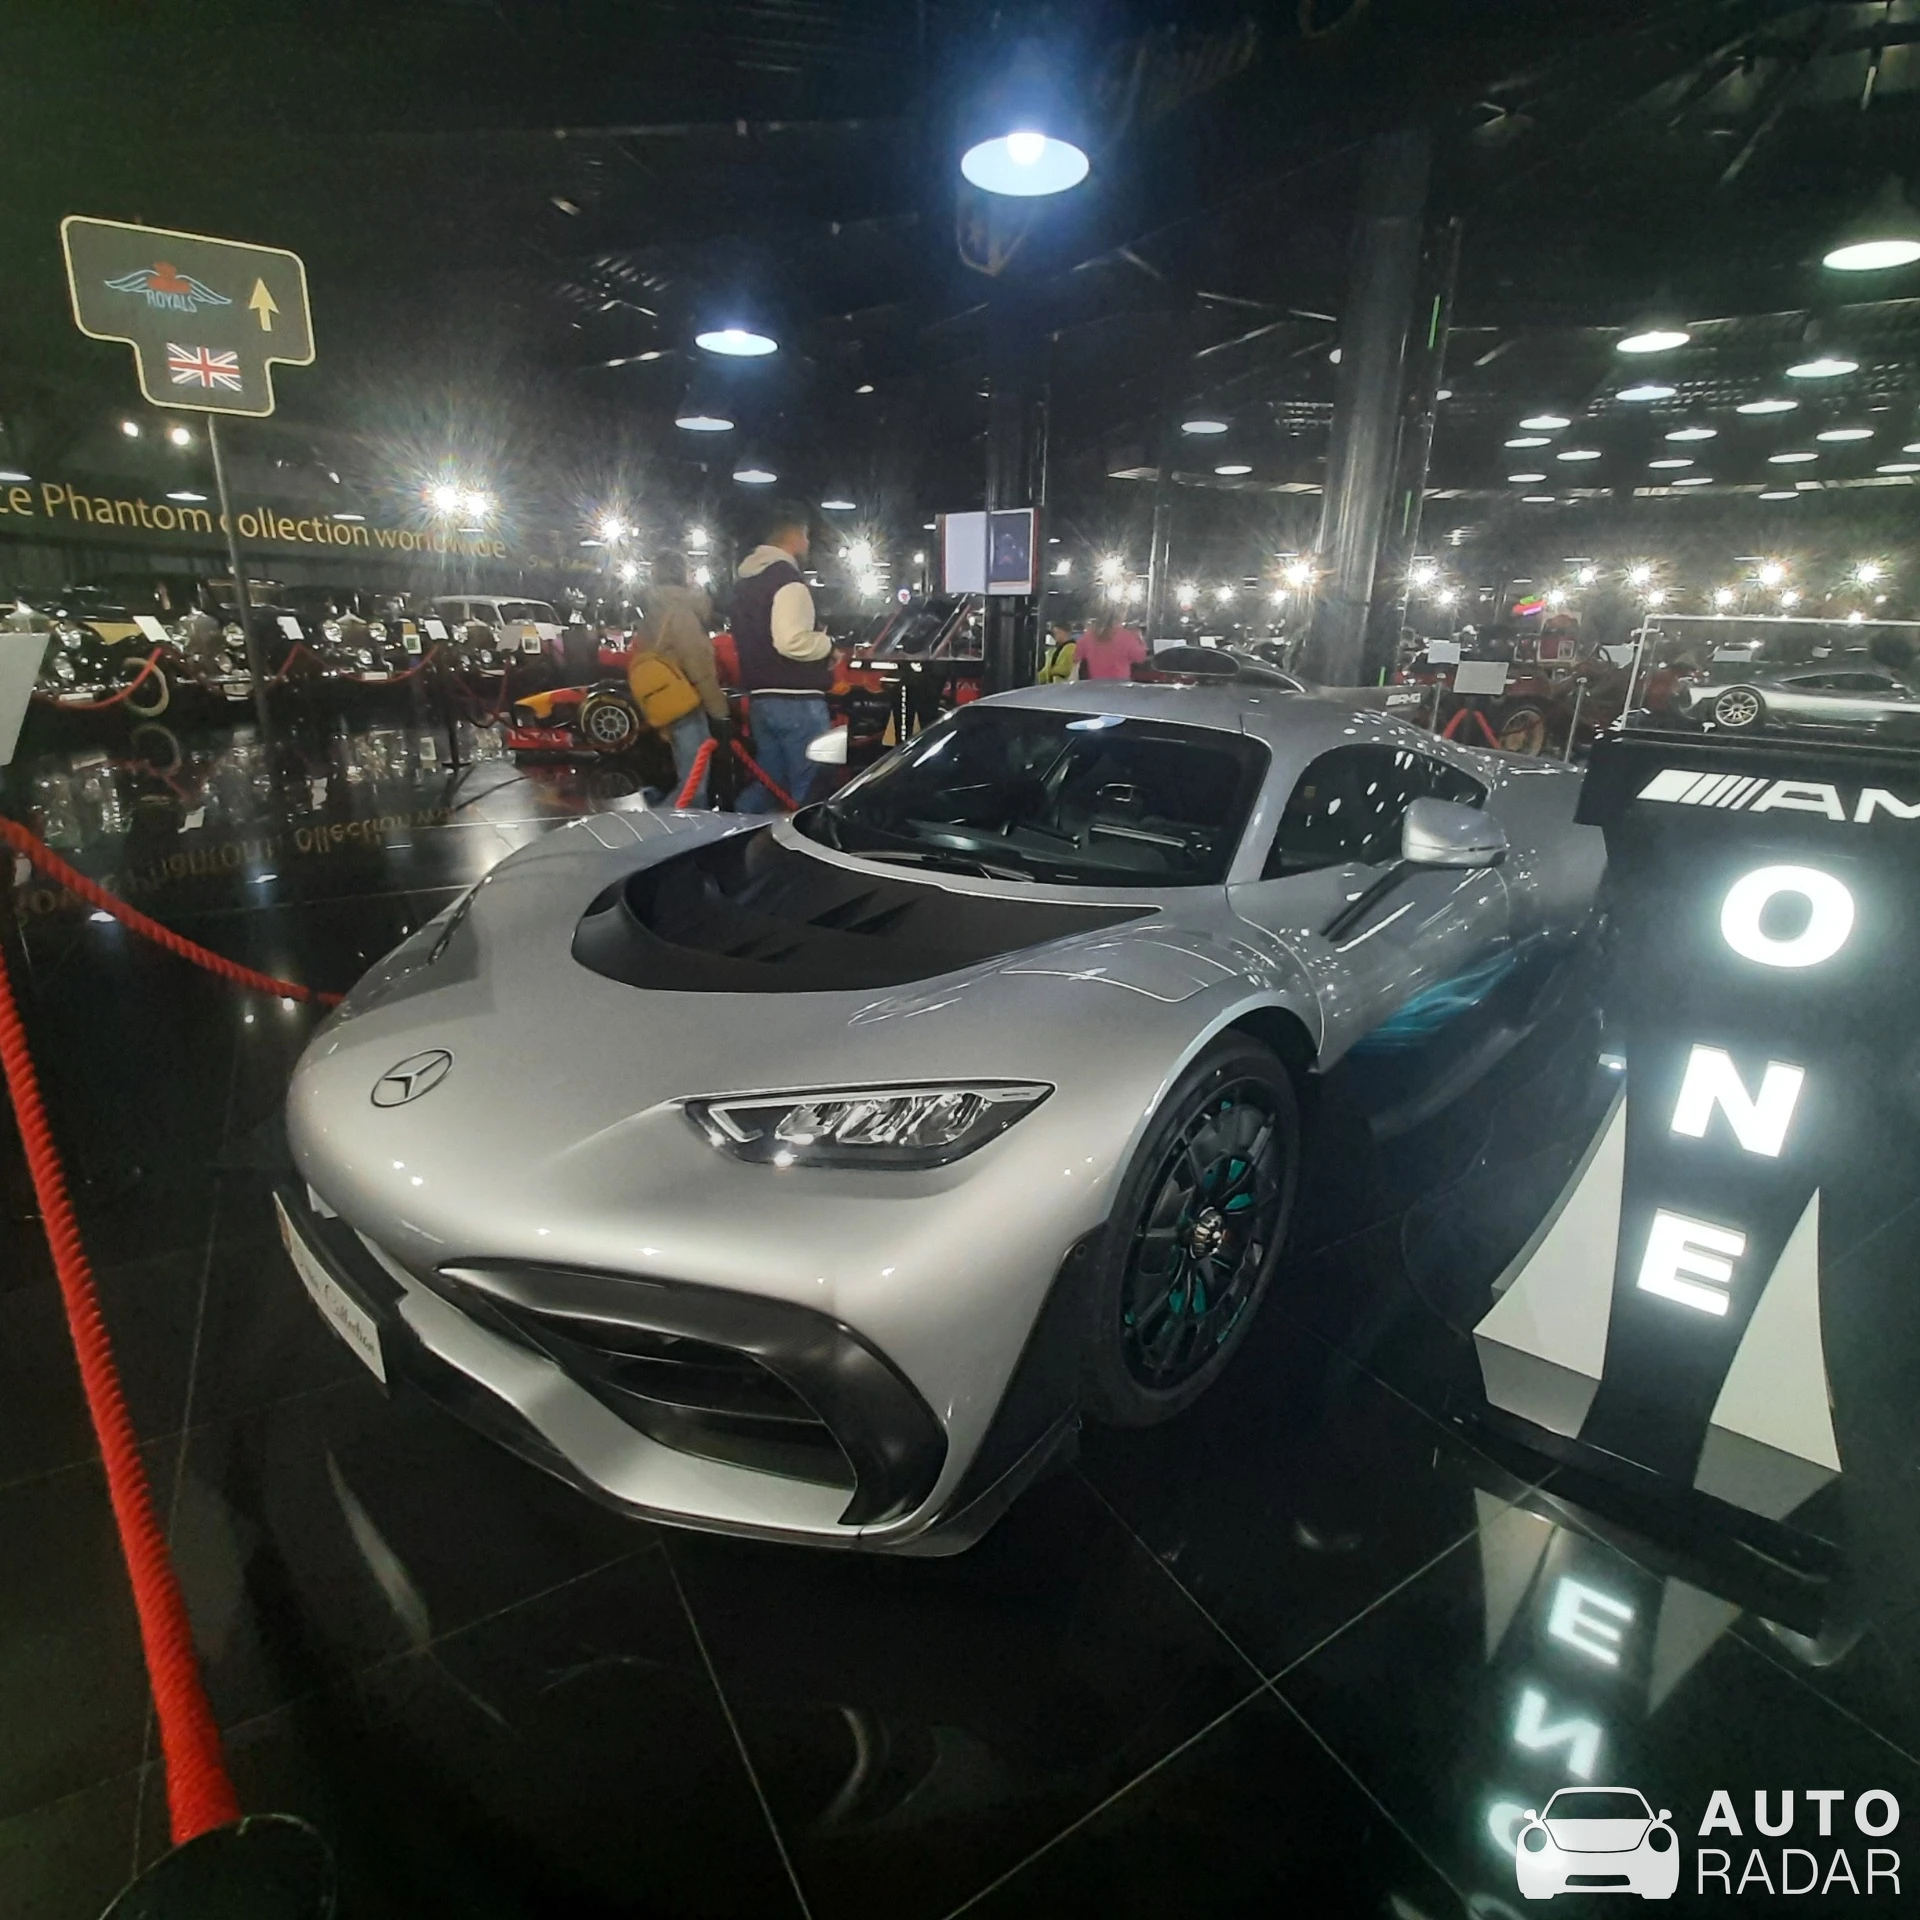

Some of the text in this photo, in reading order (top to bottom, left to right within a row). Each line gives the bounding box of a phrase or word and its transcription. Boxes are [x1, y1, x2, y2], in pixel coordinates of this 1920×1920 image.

[145, 289, 197, 312] ROYALS
[41, 482, 212, 533] Phantom
[374, 527, 506, 558] worldwide
[1637, 865, 1855, 1316] ONE
